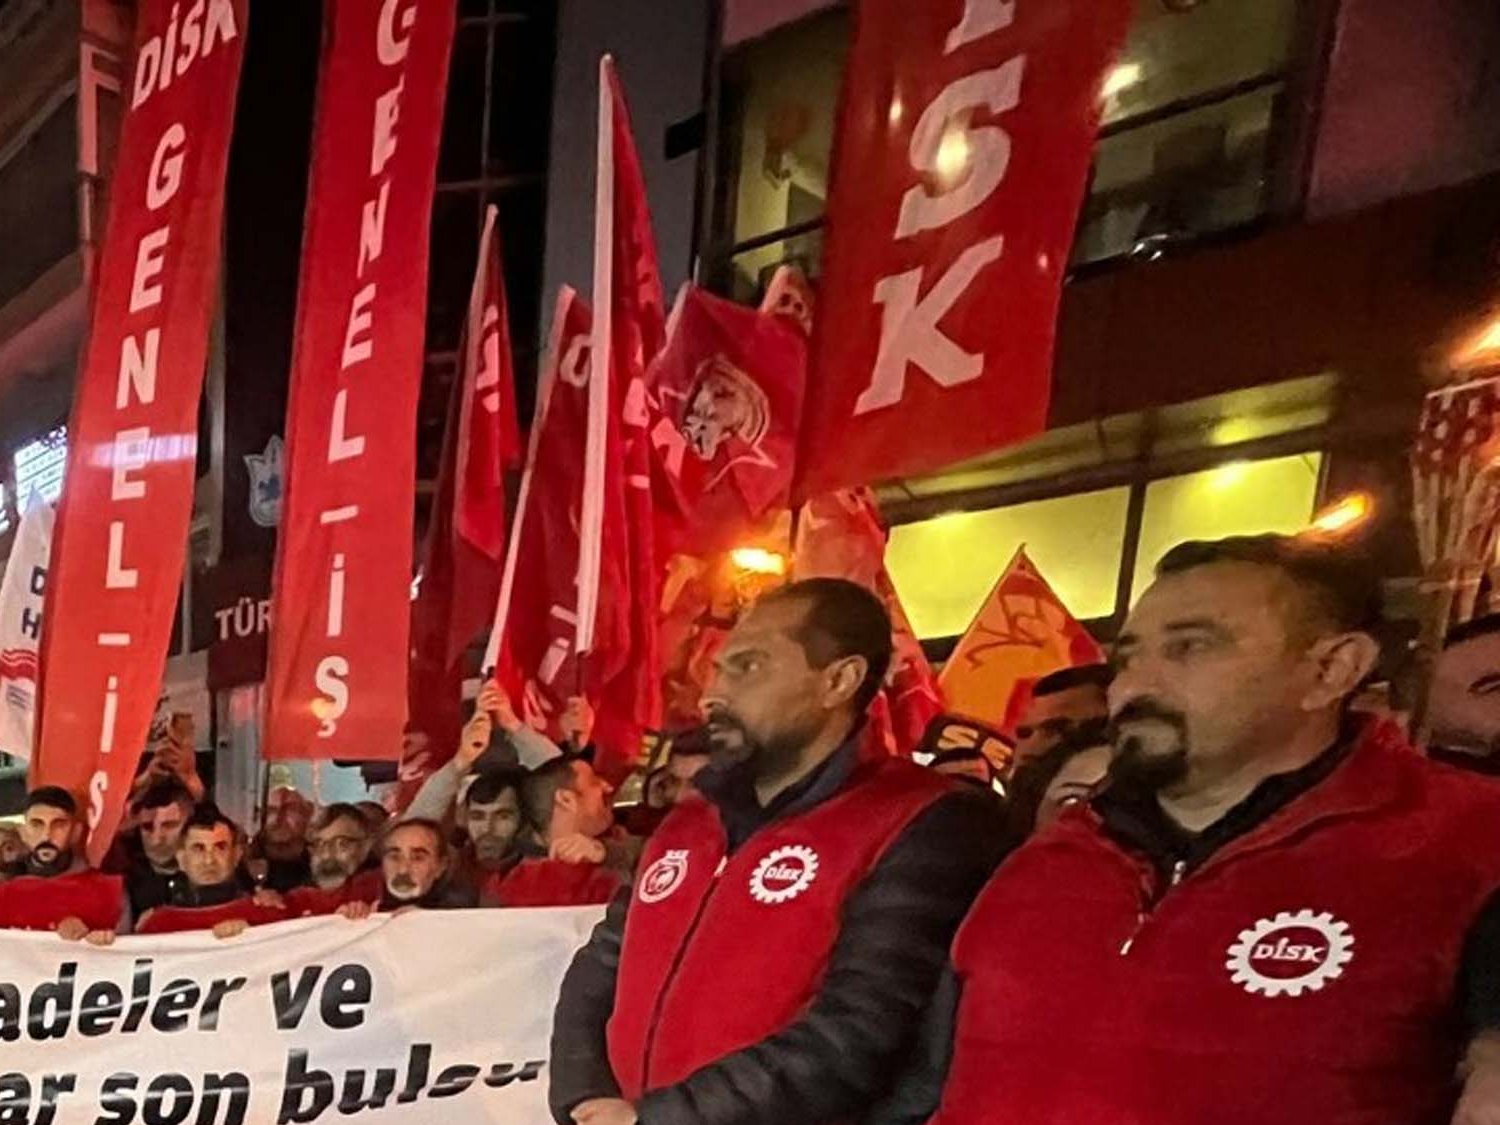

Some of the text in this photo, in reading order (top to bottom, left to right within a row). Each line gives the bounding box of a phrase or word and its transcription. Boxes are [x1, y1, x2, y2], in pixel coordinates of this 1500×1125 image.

[131, 0, 238, 111] DİSK
[1252, 937, 1325, 963] DİSK
[269, 962, 373, 1031] ve
[278, 1043, 547, 1125] bulsu
